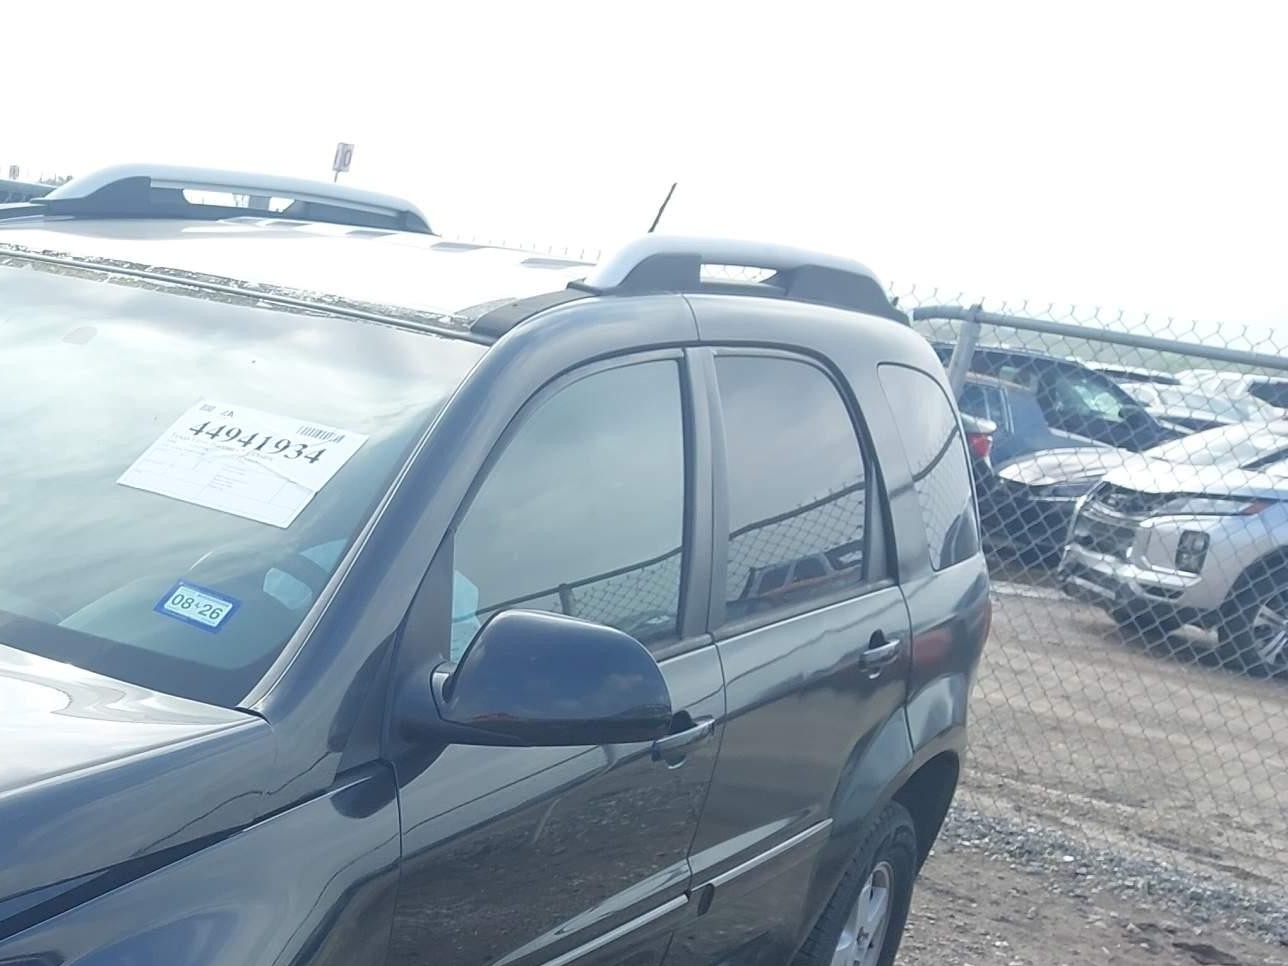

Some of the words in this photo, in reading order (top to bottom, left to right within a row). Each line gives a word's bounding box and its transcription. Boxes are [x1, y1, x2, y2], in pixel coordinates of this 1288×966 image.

[189, 421, 327, 464] 44941934
[171, 593, 194, 609] 08
[198, 603, 223, 620] 26
